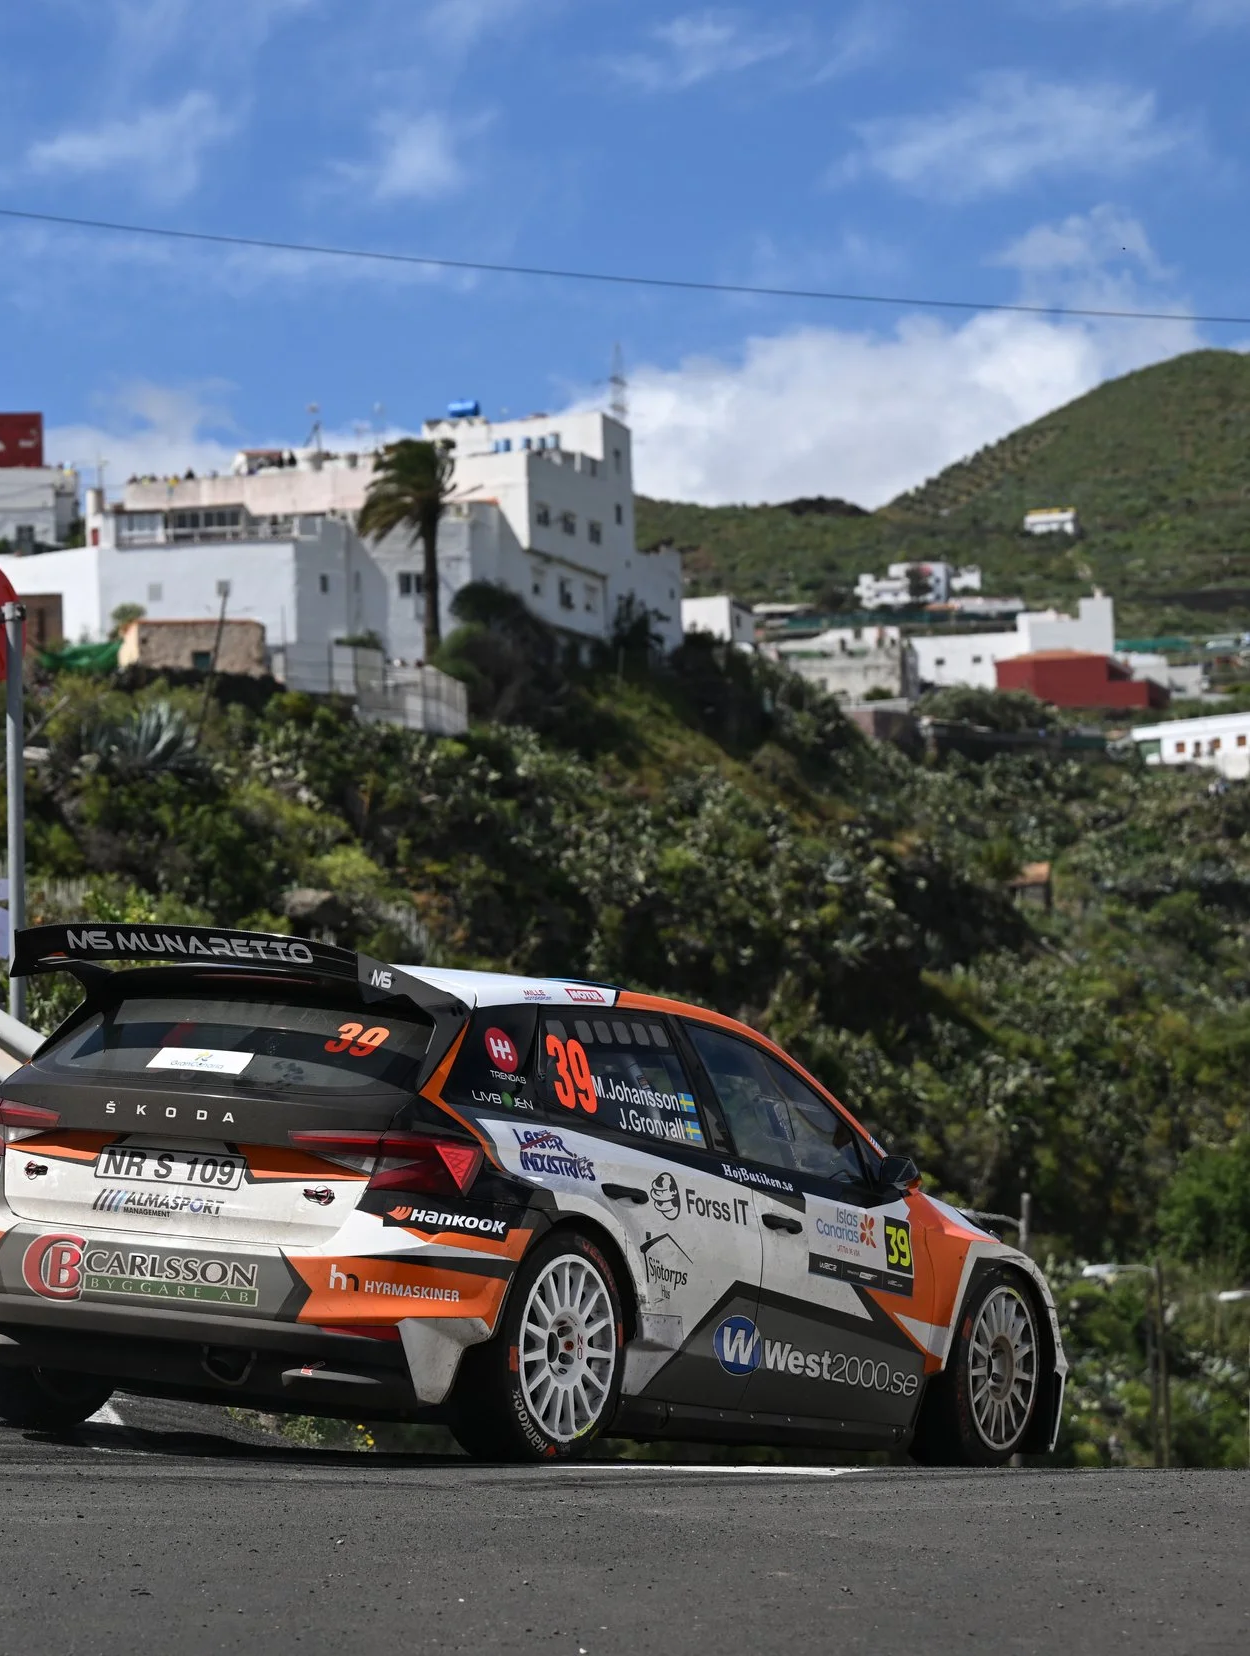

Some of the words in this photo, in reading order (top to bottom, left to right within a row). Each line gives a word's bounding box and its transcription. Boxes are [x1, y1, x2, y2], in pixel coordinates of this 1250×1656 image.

[66, 929, 112, 951] MS
[117, 931, 314, 964] MUNARETTO
[371, 968, 392, 989] MS
[568, 990, 602, 1000] MOTUL
[324, 1022, 390, 1057] 39
[545, 1034, 598, 1114] 39
[591, 1075, 680, 1112] M.Johansson
[619, 1108, 686, 1140] J.Gronvall
[103, 1150, 147, 1176] NR
[153, 1153, 175, 1179] S
[187, 1157, 236, 1185] 109
[721, 1163, 794, 1192] HojButiken.se
[123, 1206, 170, 1218] MANAGEMENT
[124, 1191, 225, 1215] ALMASPORT
[685, 1188, 731, 1222] Forss
[733, 1198, 749, 1225] IT
[836, 1207, 858, 1227] Islas
[816, 1218, 859, 1243] Canarias
[885, 1225, 911, 1267] 39
[83, 1250, 259, 1289] CARLSSON
[90, 1277, 202, 1298] BYGGARE
[220, 1288, 249, 1302] AB
[364, 1280, 460, 1302] HYRMASKINER
[764, 1339, 918, 1397] West2000.se
